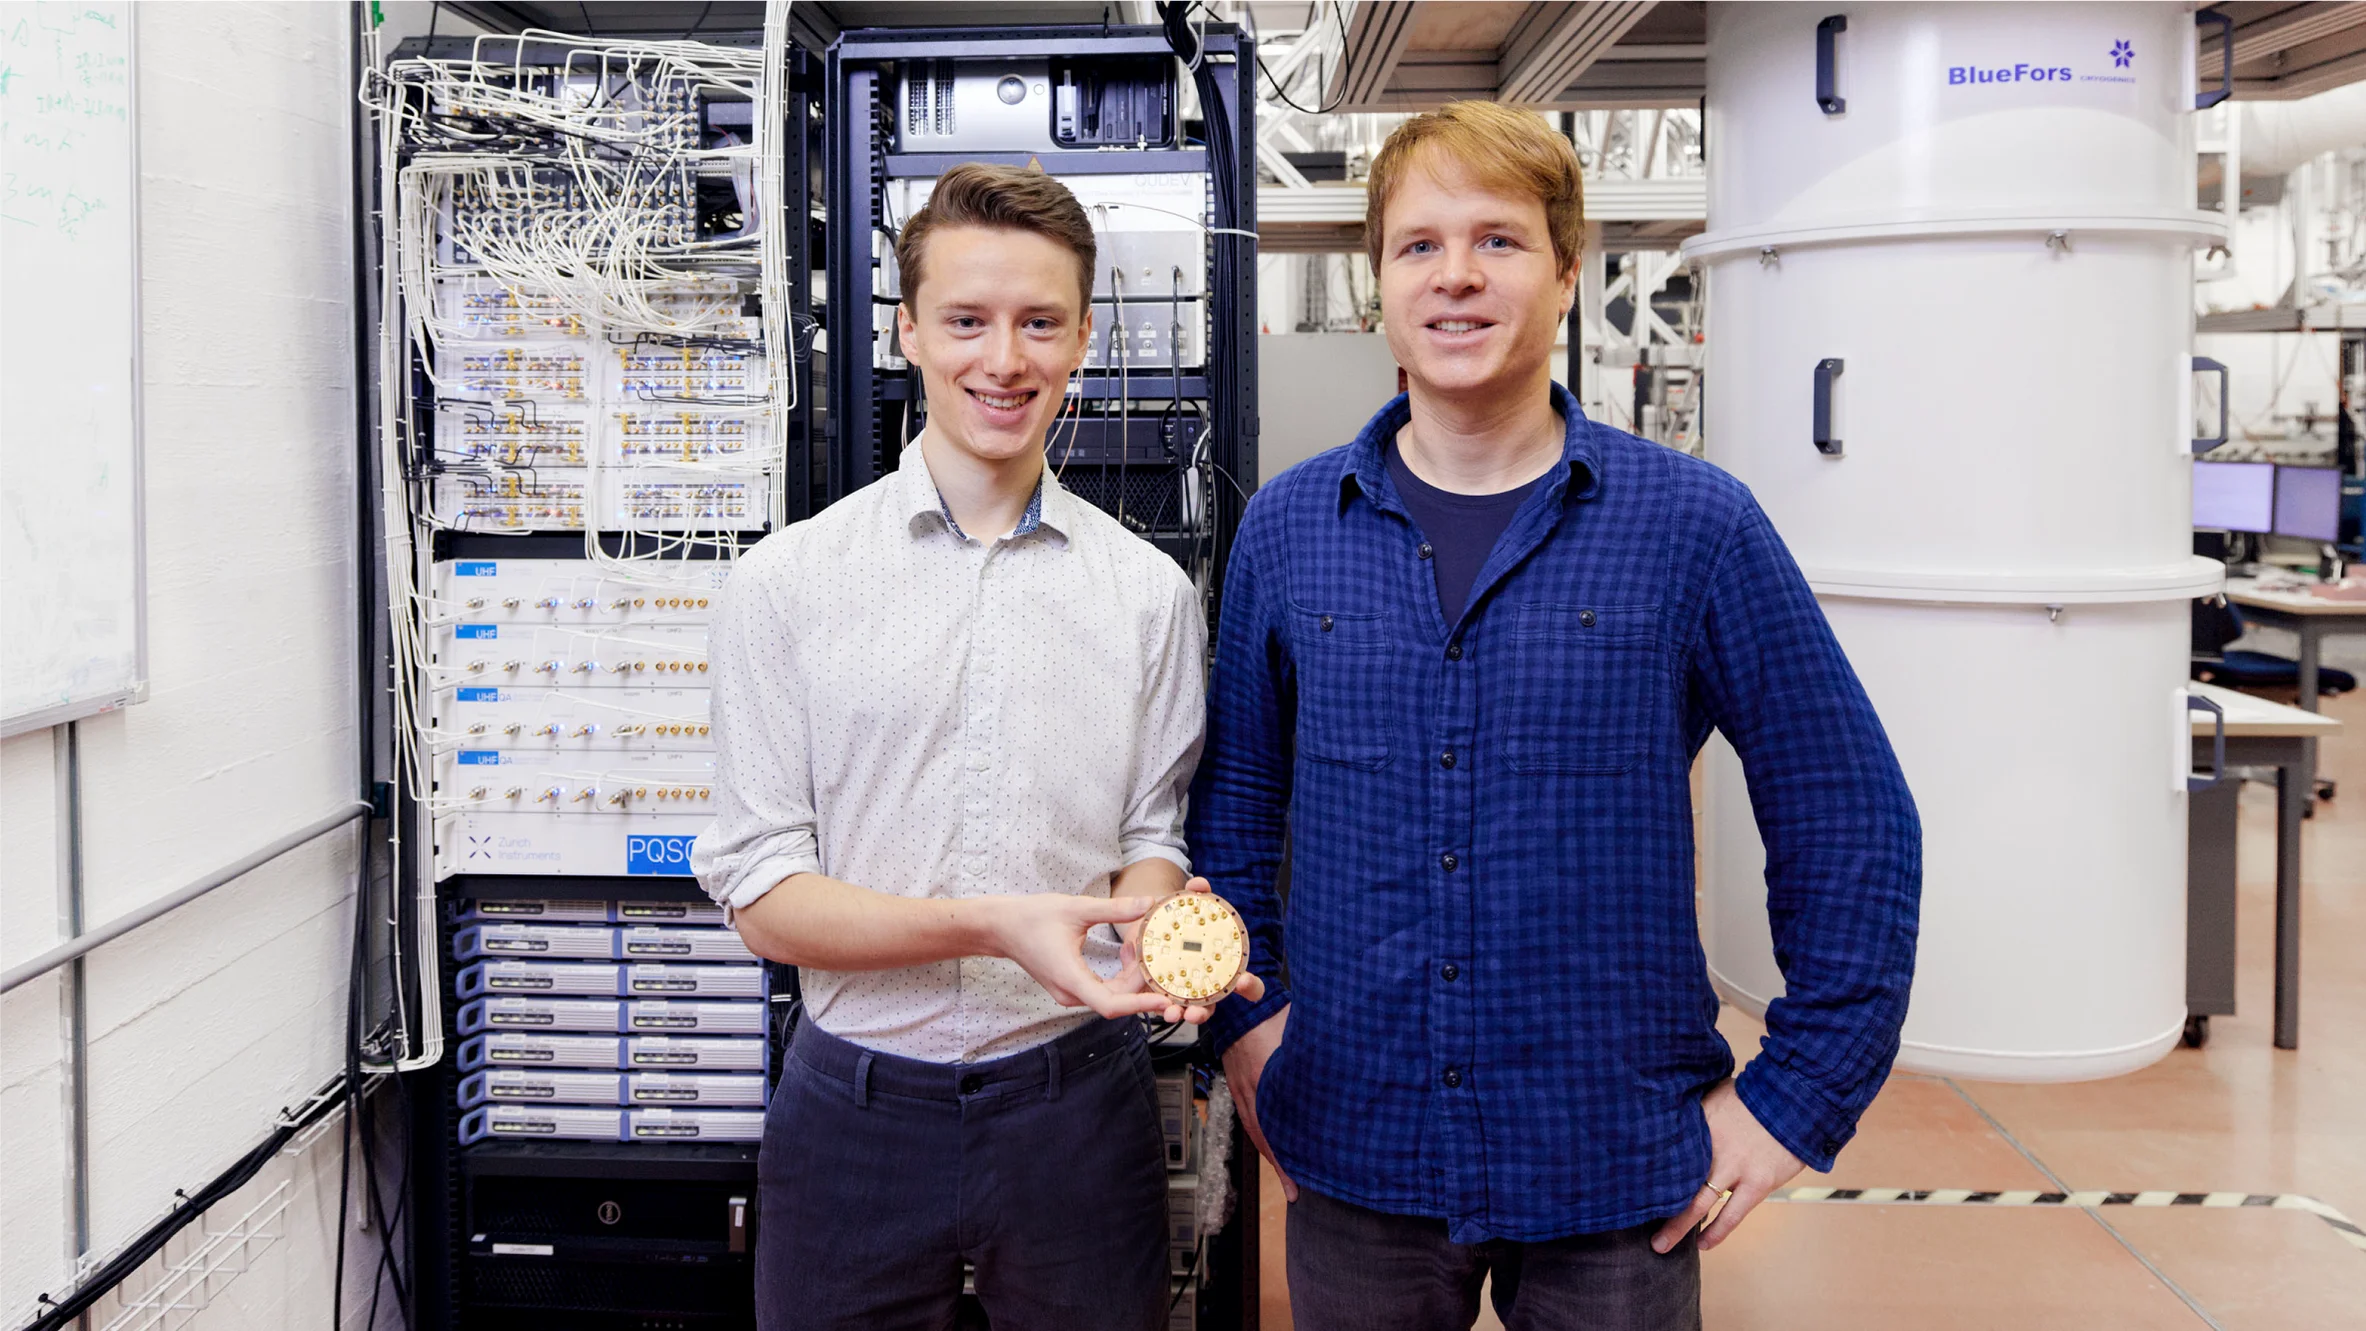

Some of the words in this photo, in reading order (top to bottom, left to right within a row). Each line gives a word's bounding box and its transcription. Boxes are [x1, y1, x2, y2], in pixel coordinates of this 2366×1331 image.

[1948, 63, 2072, 85] BlueFors
[2080, 75, 2136, 84] CRYOGENICS
[475, 567, 496, 577] UHF
[476, 629, 496, 639] UHF
[498, 836, 531, 848] Zurich
[498, 850, 561, 861] Instruments
